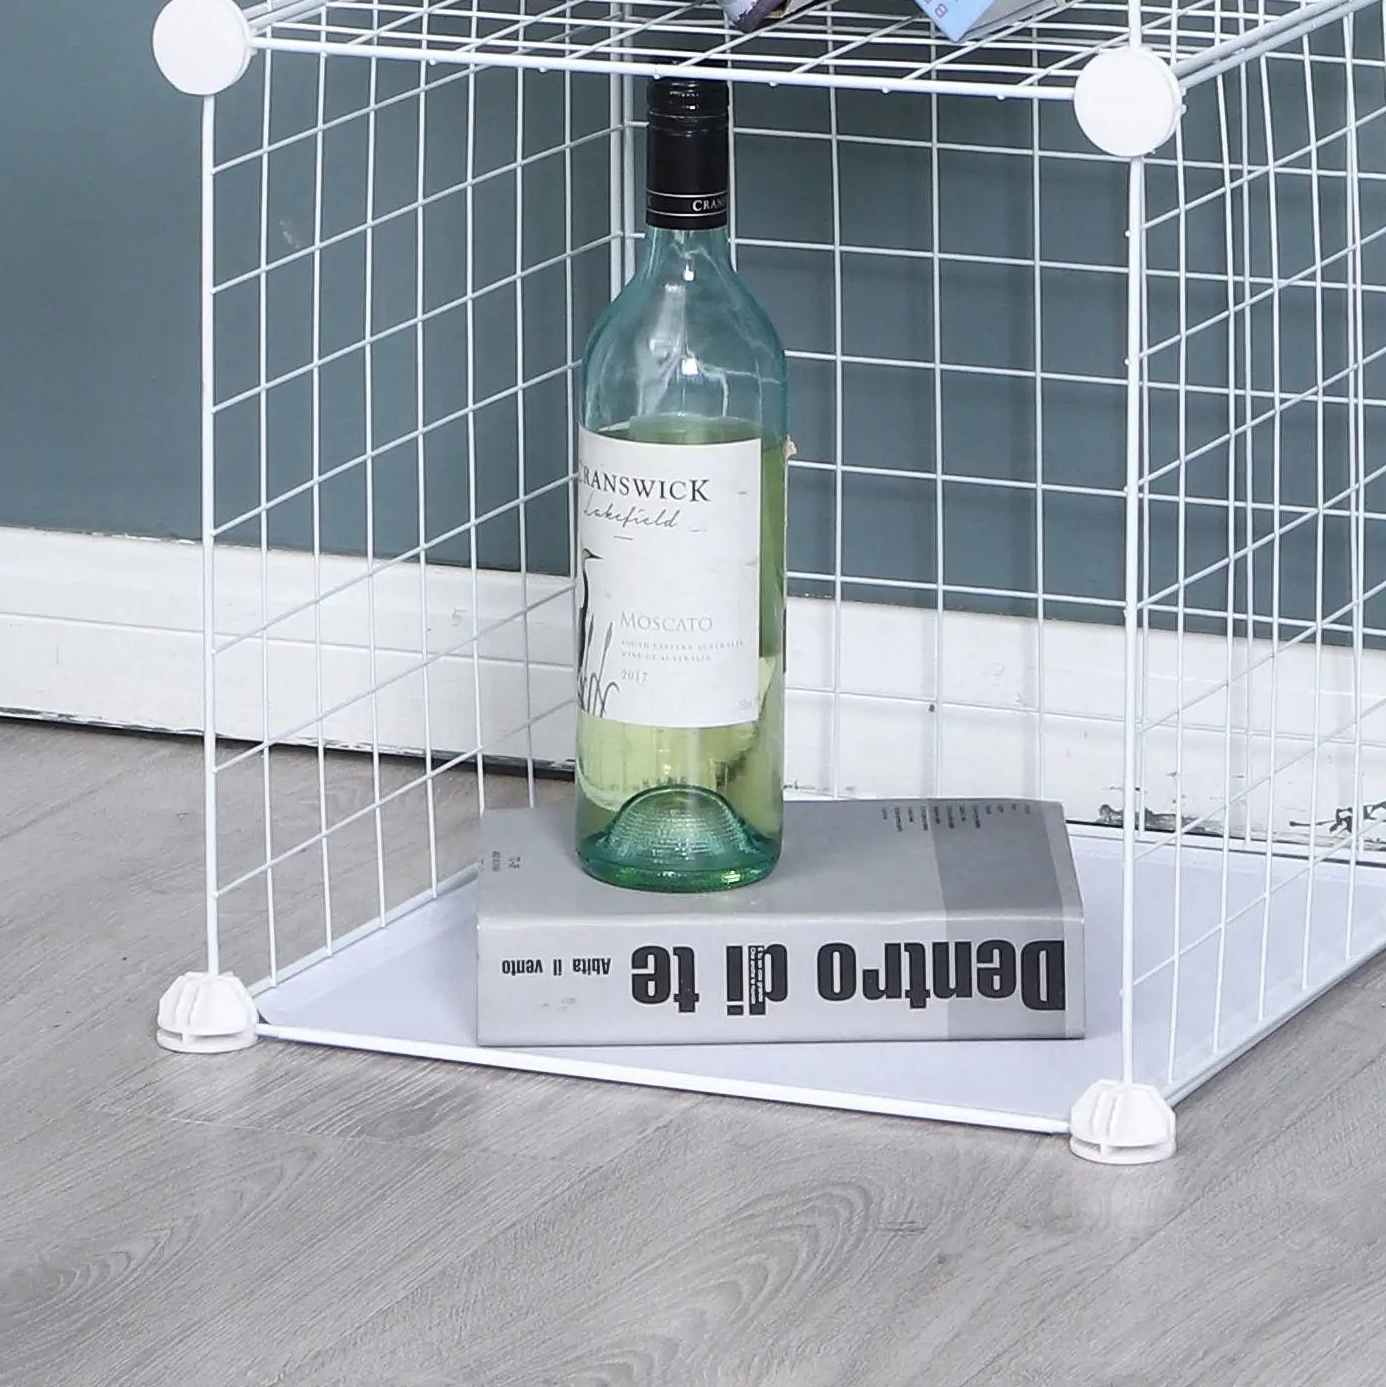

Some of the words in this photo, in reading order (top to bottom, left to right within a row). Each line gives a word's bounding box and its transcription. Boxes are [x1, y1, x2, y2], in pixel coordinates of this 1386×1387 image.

[579, 462, 711, 502] RANSWICK
[620, 610, 713, 633] MOSCATO
[621, 669, 648, 683] 2017
[502, 957, 545, 976] vento
[553, 955, 565, 976] il
[572, 955, 612, 975] Abita
[817, 939, 1066, 1012] Dentro
[630, 943, 700, 1014] te
[726, 943, 790, 1016] di
